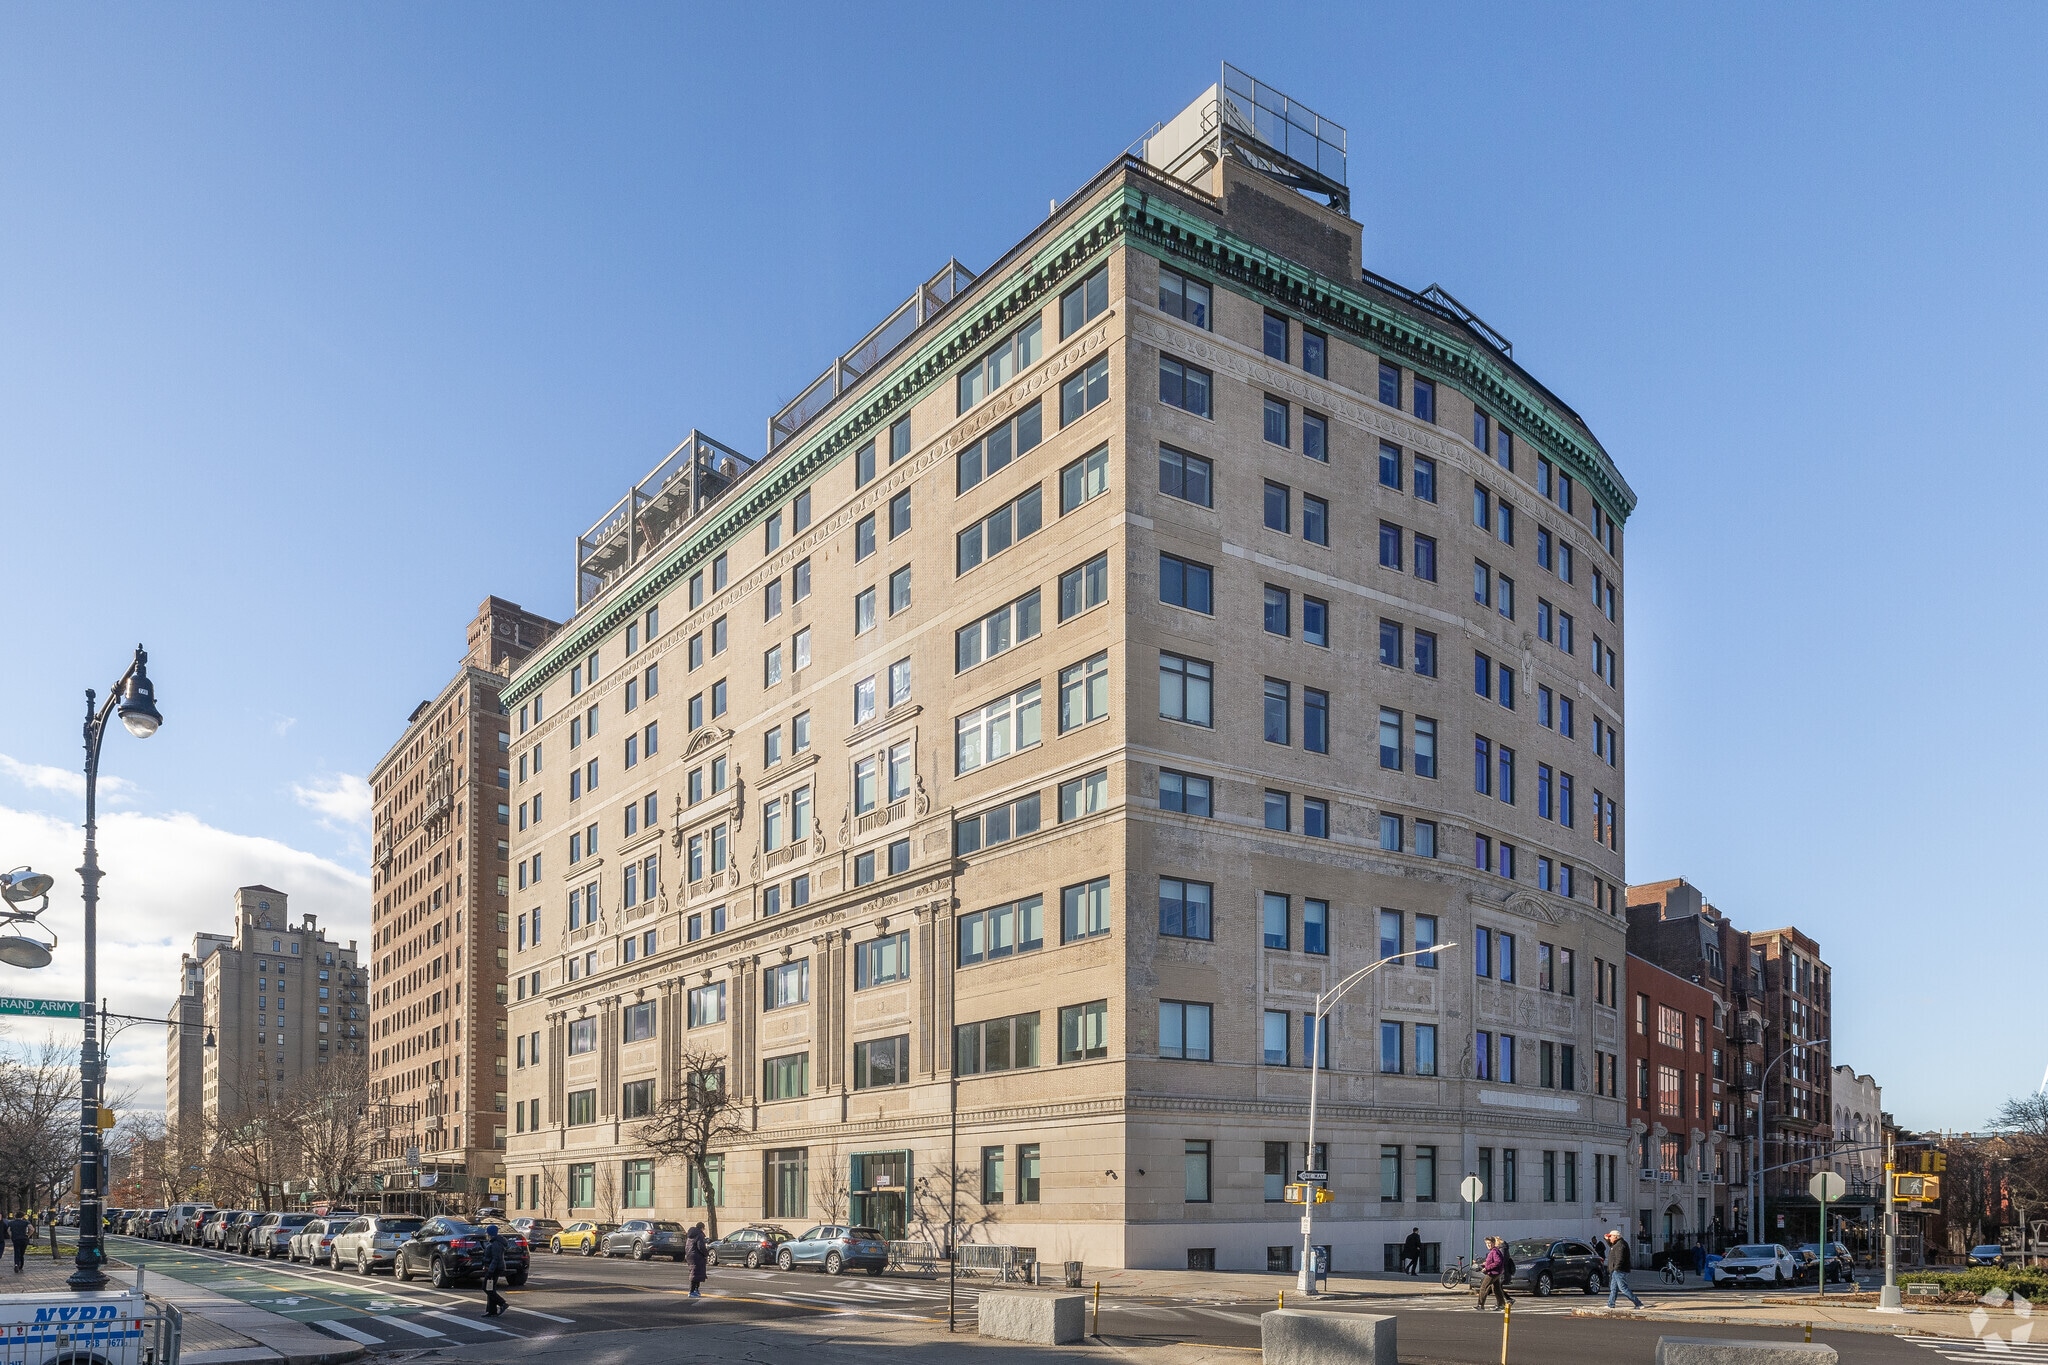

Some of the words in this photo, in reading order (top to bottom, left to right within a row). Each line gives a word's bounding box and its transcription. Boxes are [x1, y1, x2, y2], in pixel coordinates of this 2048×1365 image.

[0, 999, 35, 1010] RAND
[40, 1001, 75, 1012] ARMY
[31, 1305, 118, 1332] NYPD
